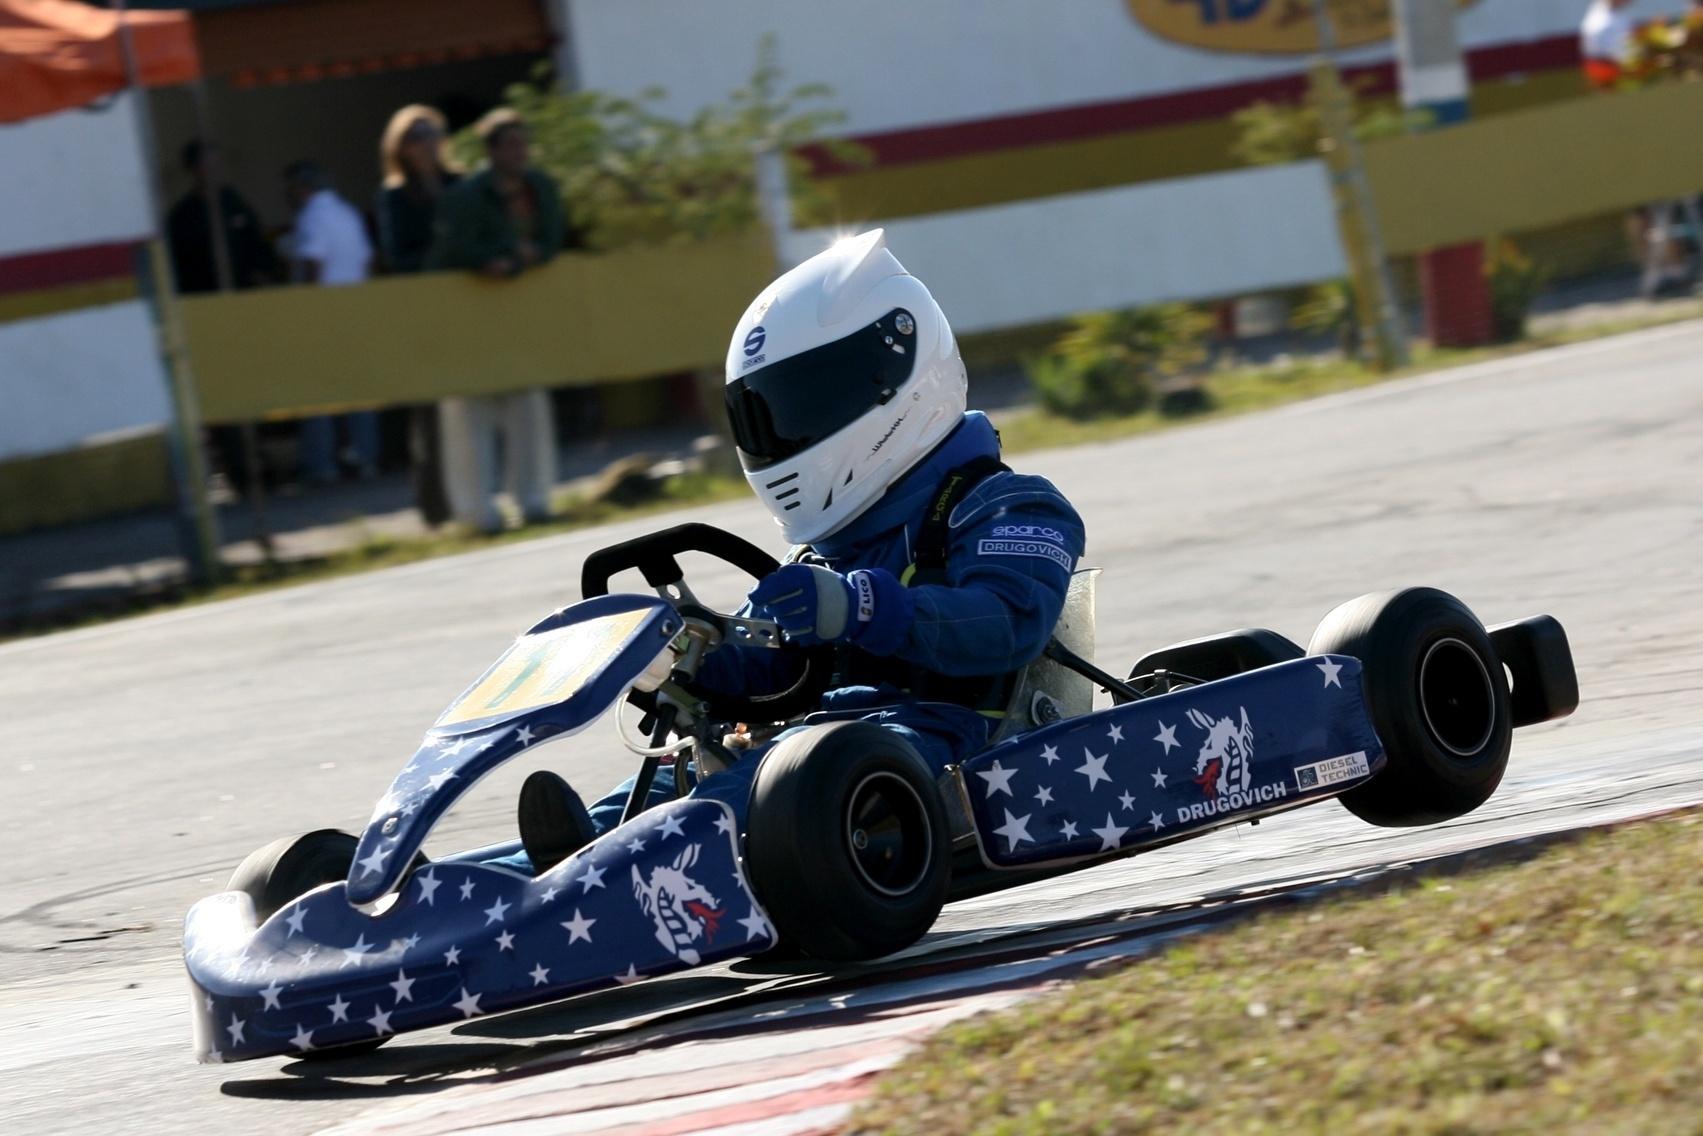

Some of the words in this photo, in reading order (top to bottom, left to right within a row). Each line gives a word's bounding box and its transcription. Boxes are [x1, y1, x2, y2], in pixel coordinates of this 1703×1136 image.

[984, 542, 1069, 566] DRUGOVICH
[1319, 756, 1358, 773] DIESEL
[1320, 764, 1368, 783] TECHNIC
[1176, 781, 1287, 824] DRUGOVICH
